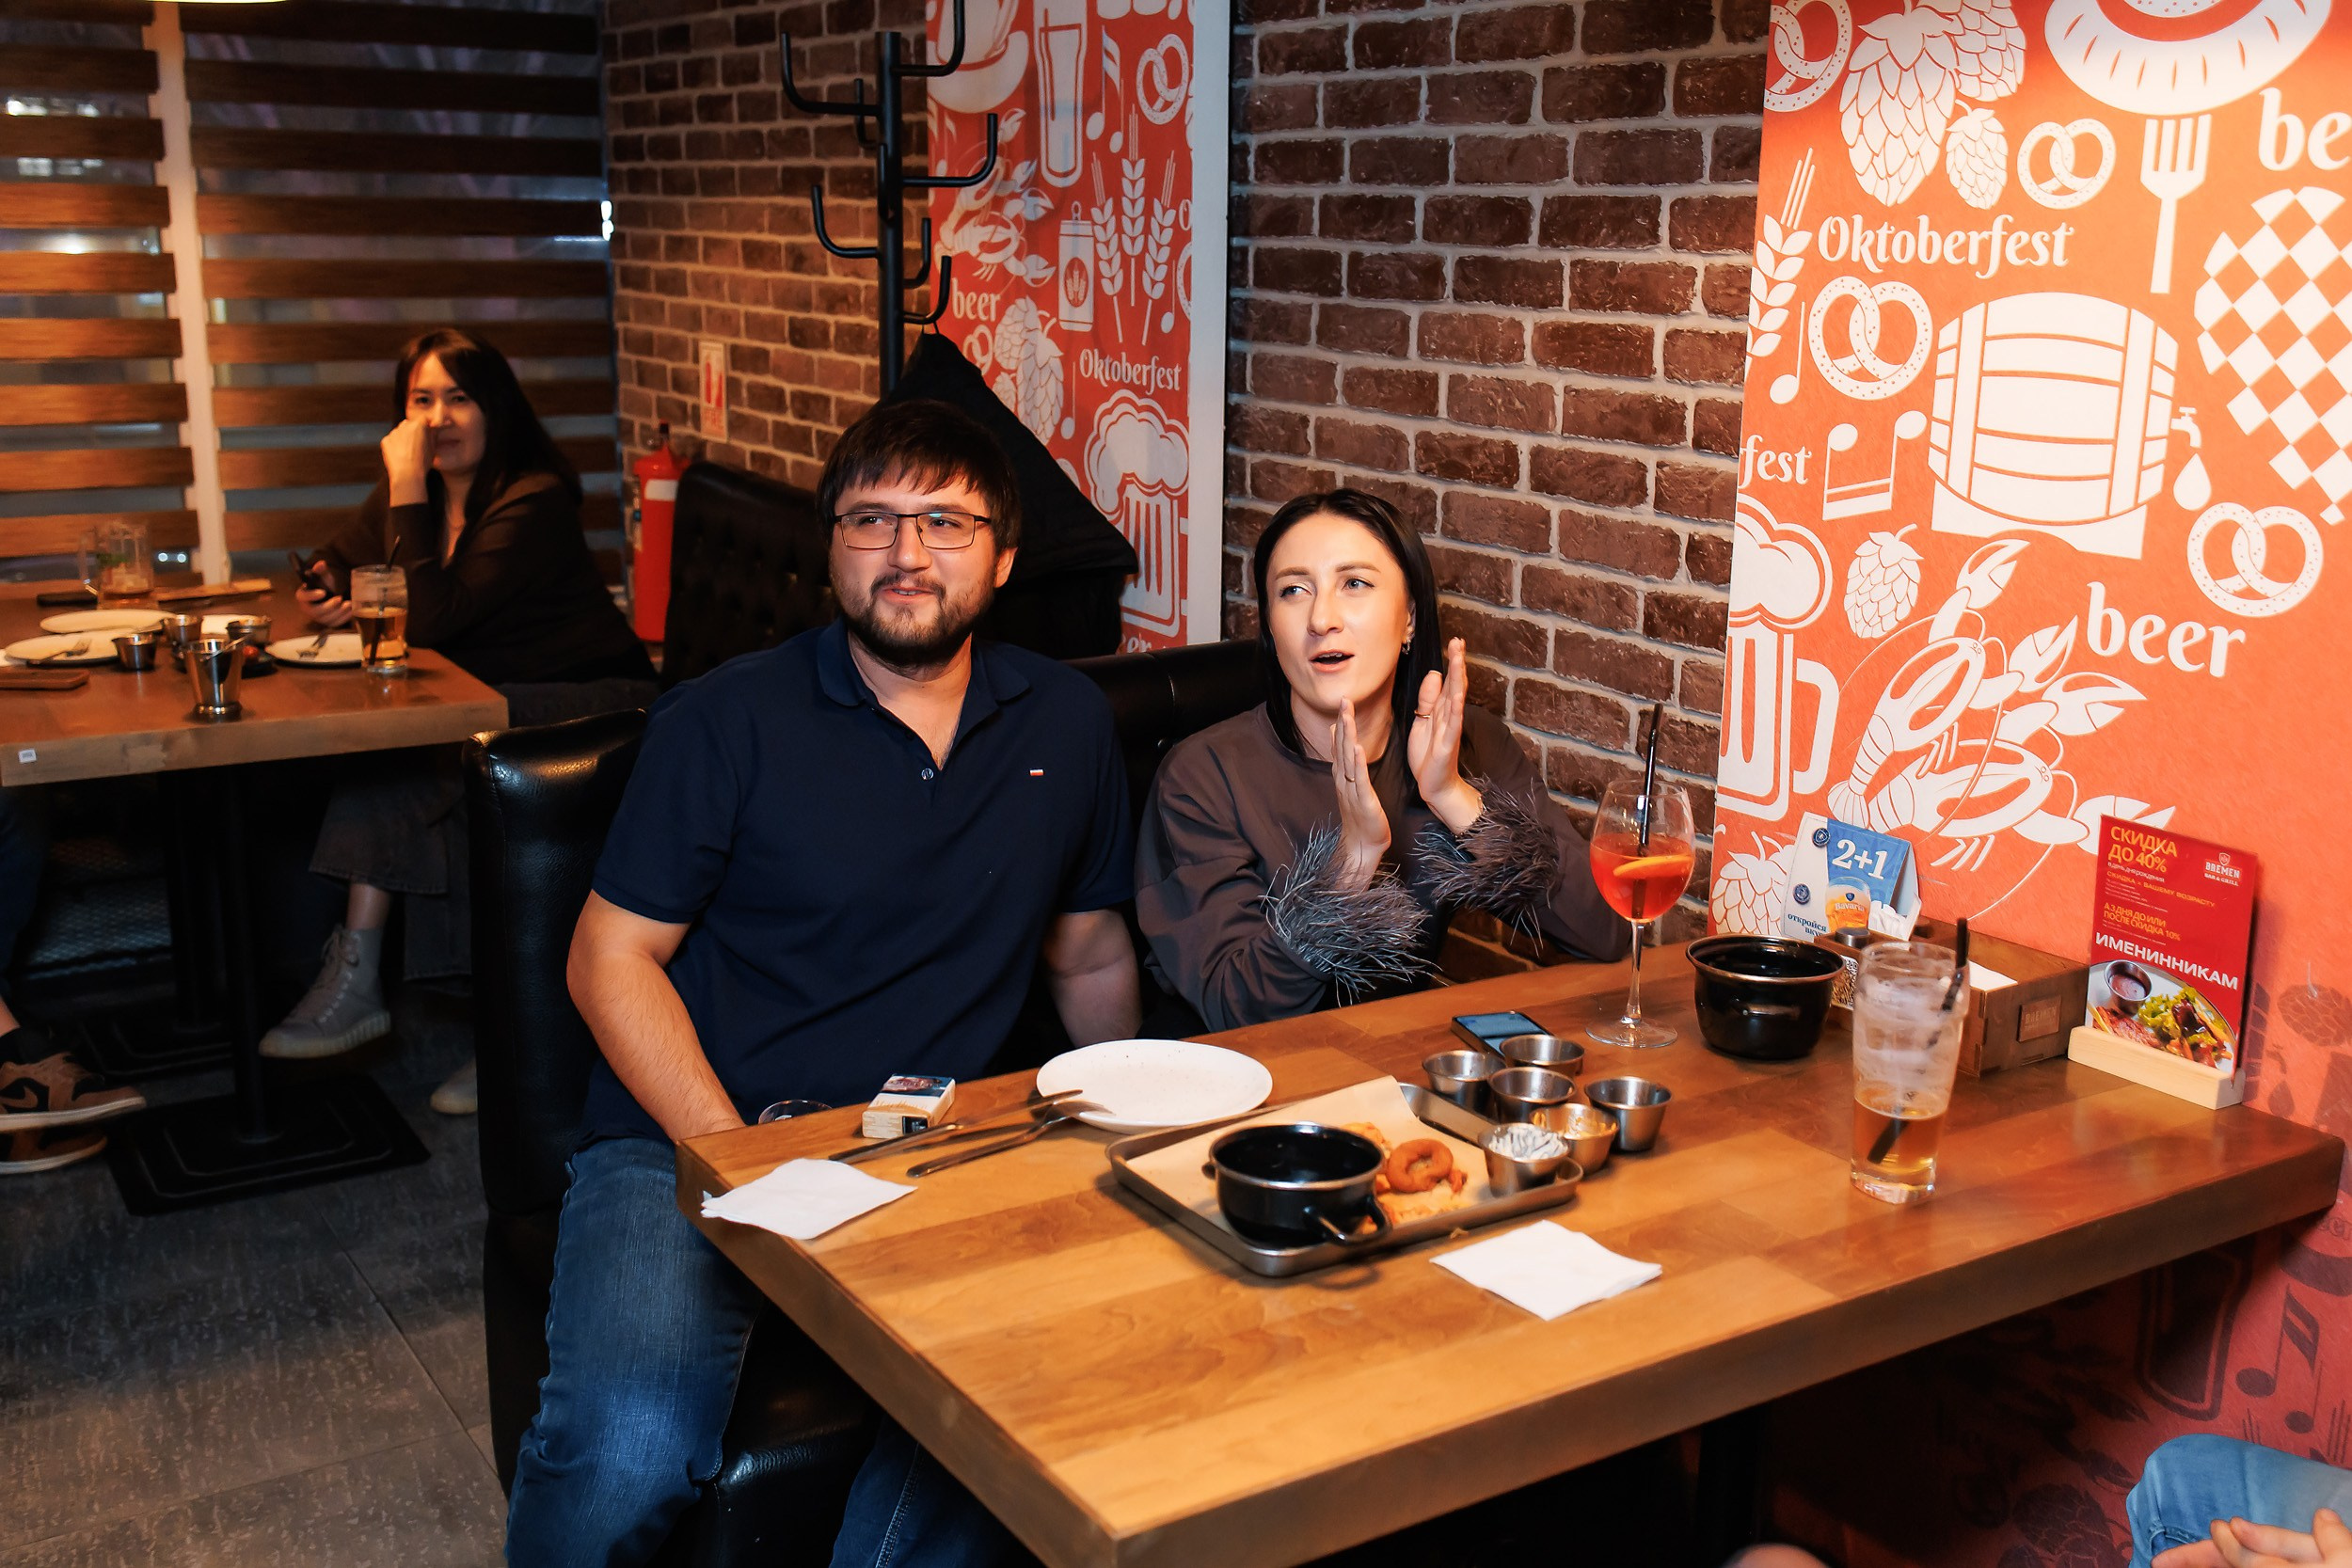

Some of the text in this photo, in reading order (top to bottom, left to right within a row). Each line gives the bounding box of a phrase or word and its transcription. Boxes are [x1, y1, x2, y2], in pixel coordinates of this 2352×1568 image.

[2258, 87, 2352, 171] be
[1818, 214, 2075, 279] Oktoberfest
[951, 277, 1001, 323] beer
[1079, 348, 1183, 395] Oktoberfest
[1738, 434, 1812, 489] fest
[2086, 580, 2247, 678] beer
[1831, 839, 1888, 880] 2+1
[2107, 844, 2167, 873] ДО 40%
[2110, 826, 2178, 858] СКИДКА
[2106, 871, 2136, 884] СКИДКА
[2143, 881, 2175, 896] ВАШЕМУ
[2175, 892, 2216, 908] ВОЗРАСТУ
[2205, 861, 2241, 879] BREMEN
[1788, 913, 1827, 933] откройся
[2104, 910, 2130, 926] ПОСЛЕ
[2130, 919, 2165, 936] СКИДКА
[2116, 906, 2134, 919] ДНЯ
[2095, 931, 2239, 990] ИМЕНИННИКАМ
